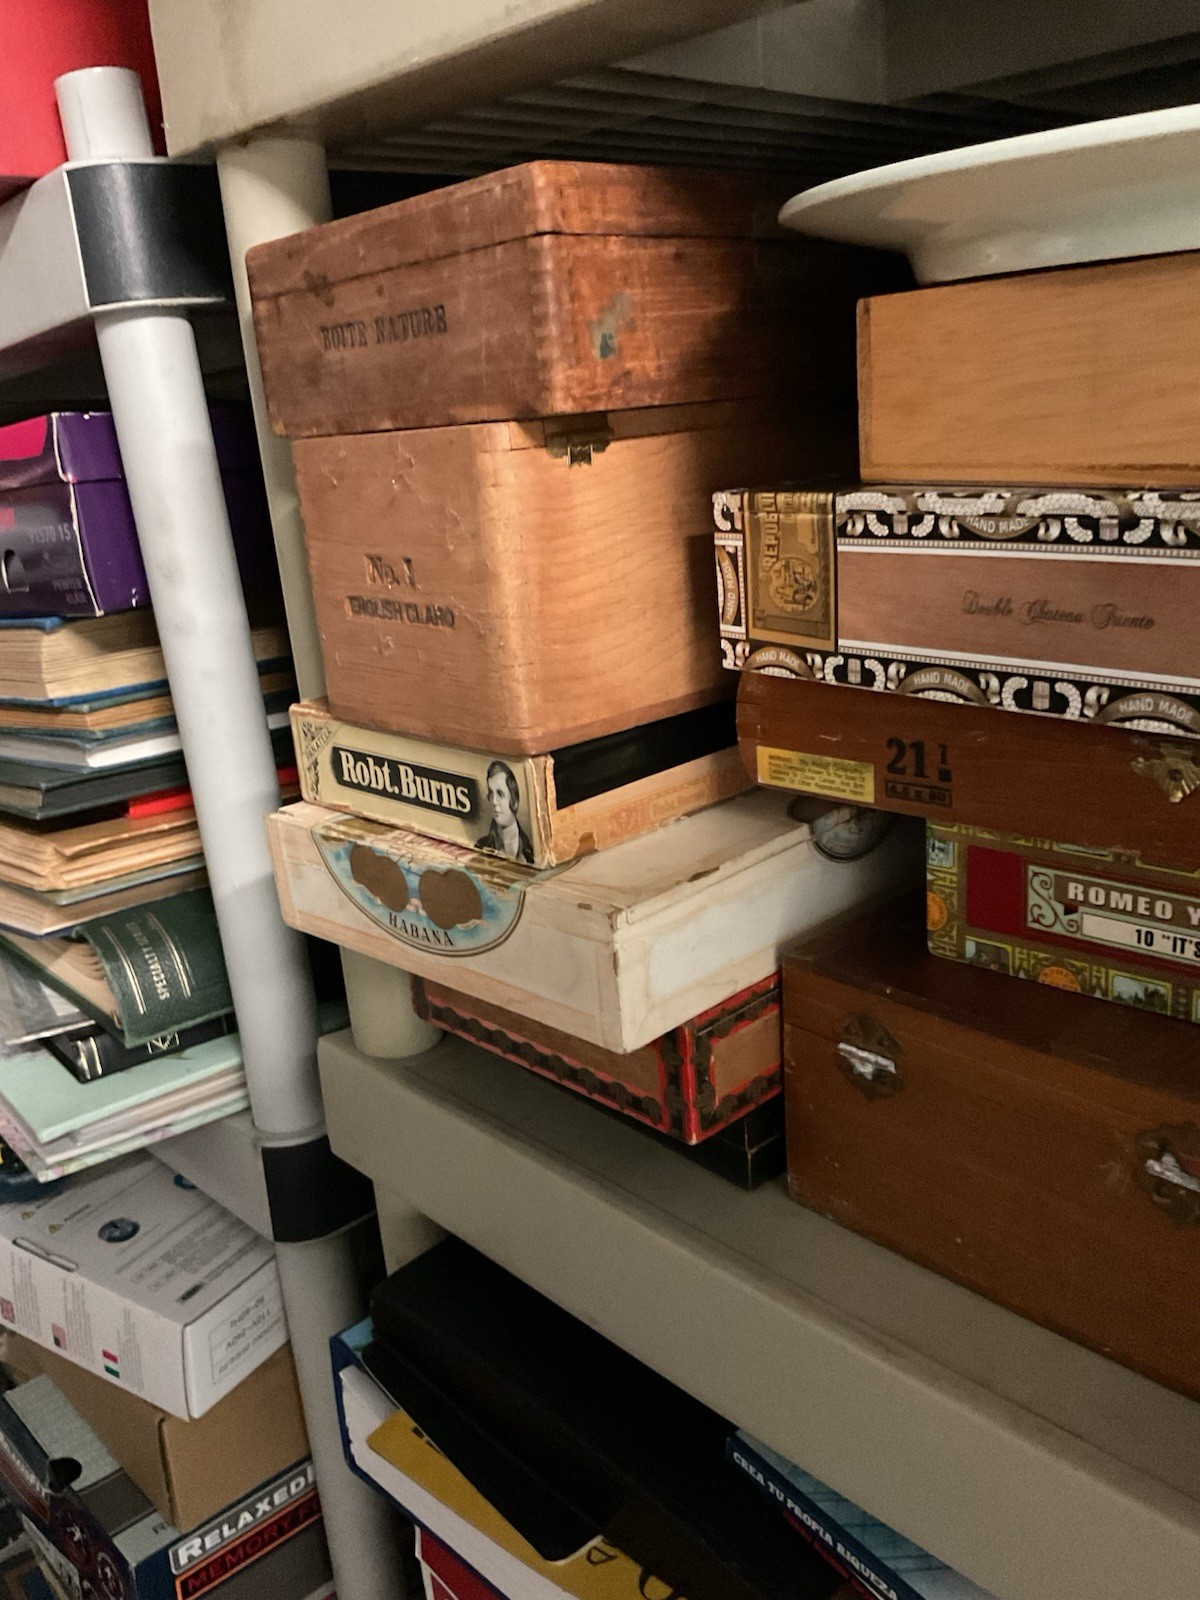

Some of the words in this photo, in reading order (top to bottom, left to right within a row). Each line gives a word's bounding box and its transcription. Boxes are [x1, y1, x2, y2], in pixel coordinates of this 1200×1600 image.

[755, 650, 778, 664] HAND
[778, 651, 801, 669] MADE
[943, 672, 970, 693] MADE
[1119, 697, 1153, 713] HAND
[1158, 698, 1193, 724] MADE
[400, 764, 472, 813] Burns
[1067, 881, 1174, 921] ROMEO
[388, 911, 455, 947] HABANA
[1135, 928, 1154, 947] 10
[732, 1451, 765, 1487] CREA
[767, 1480, 785, 1502] TU
[786, 1498, 835, 1547] PROPIA
[177, 1475, 306, 1567] RELAXED
